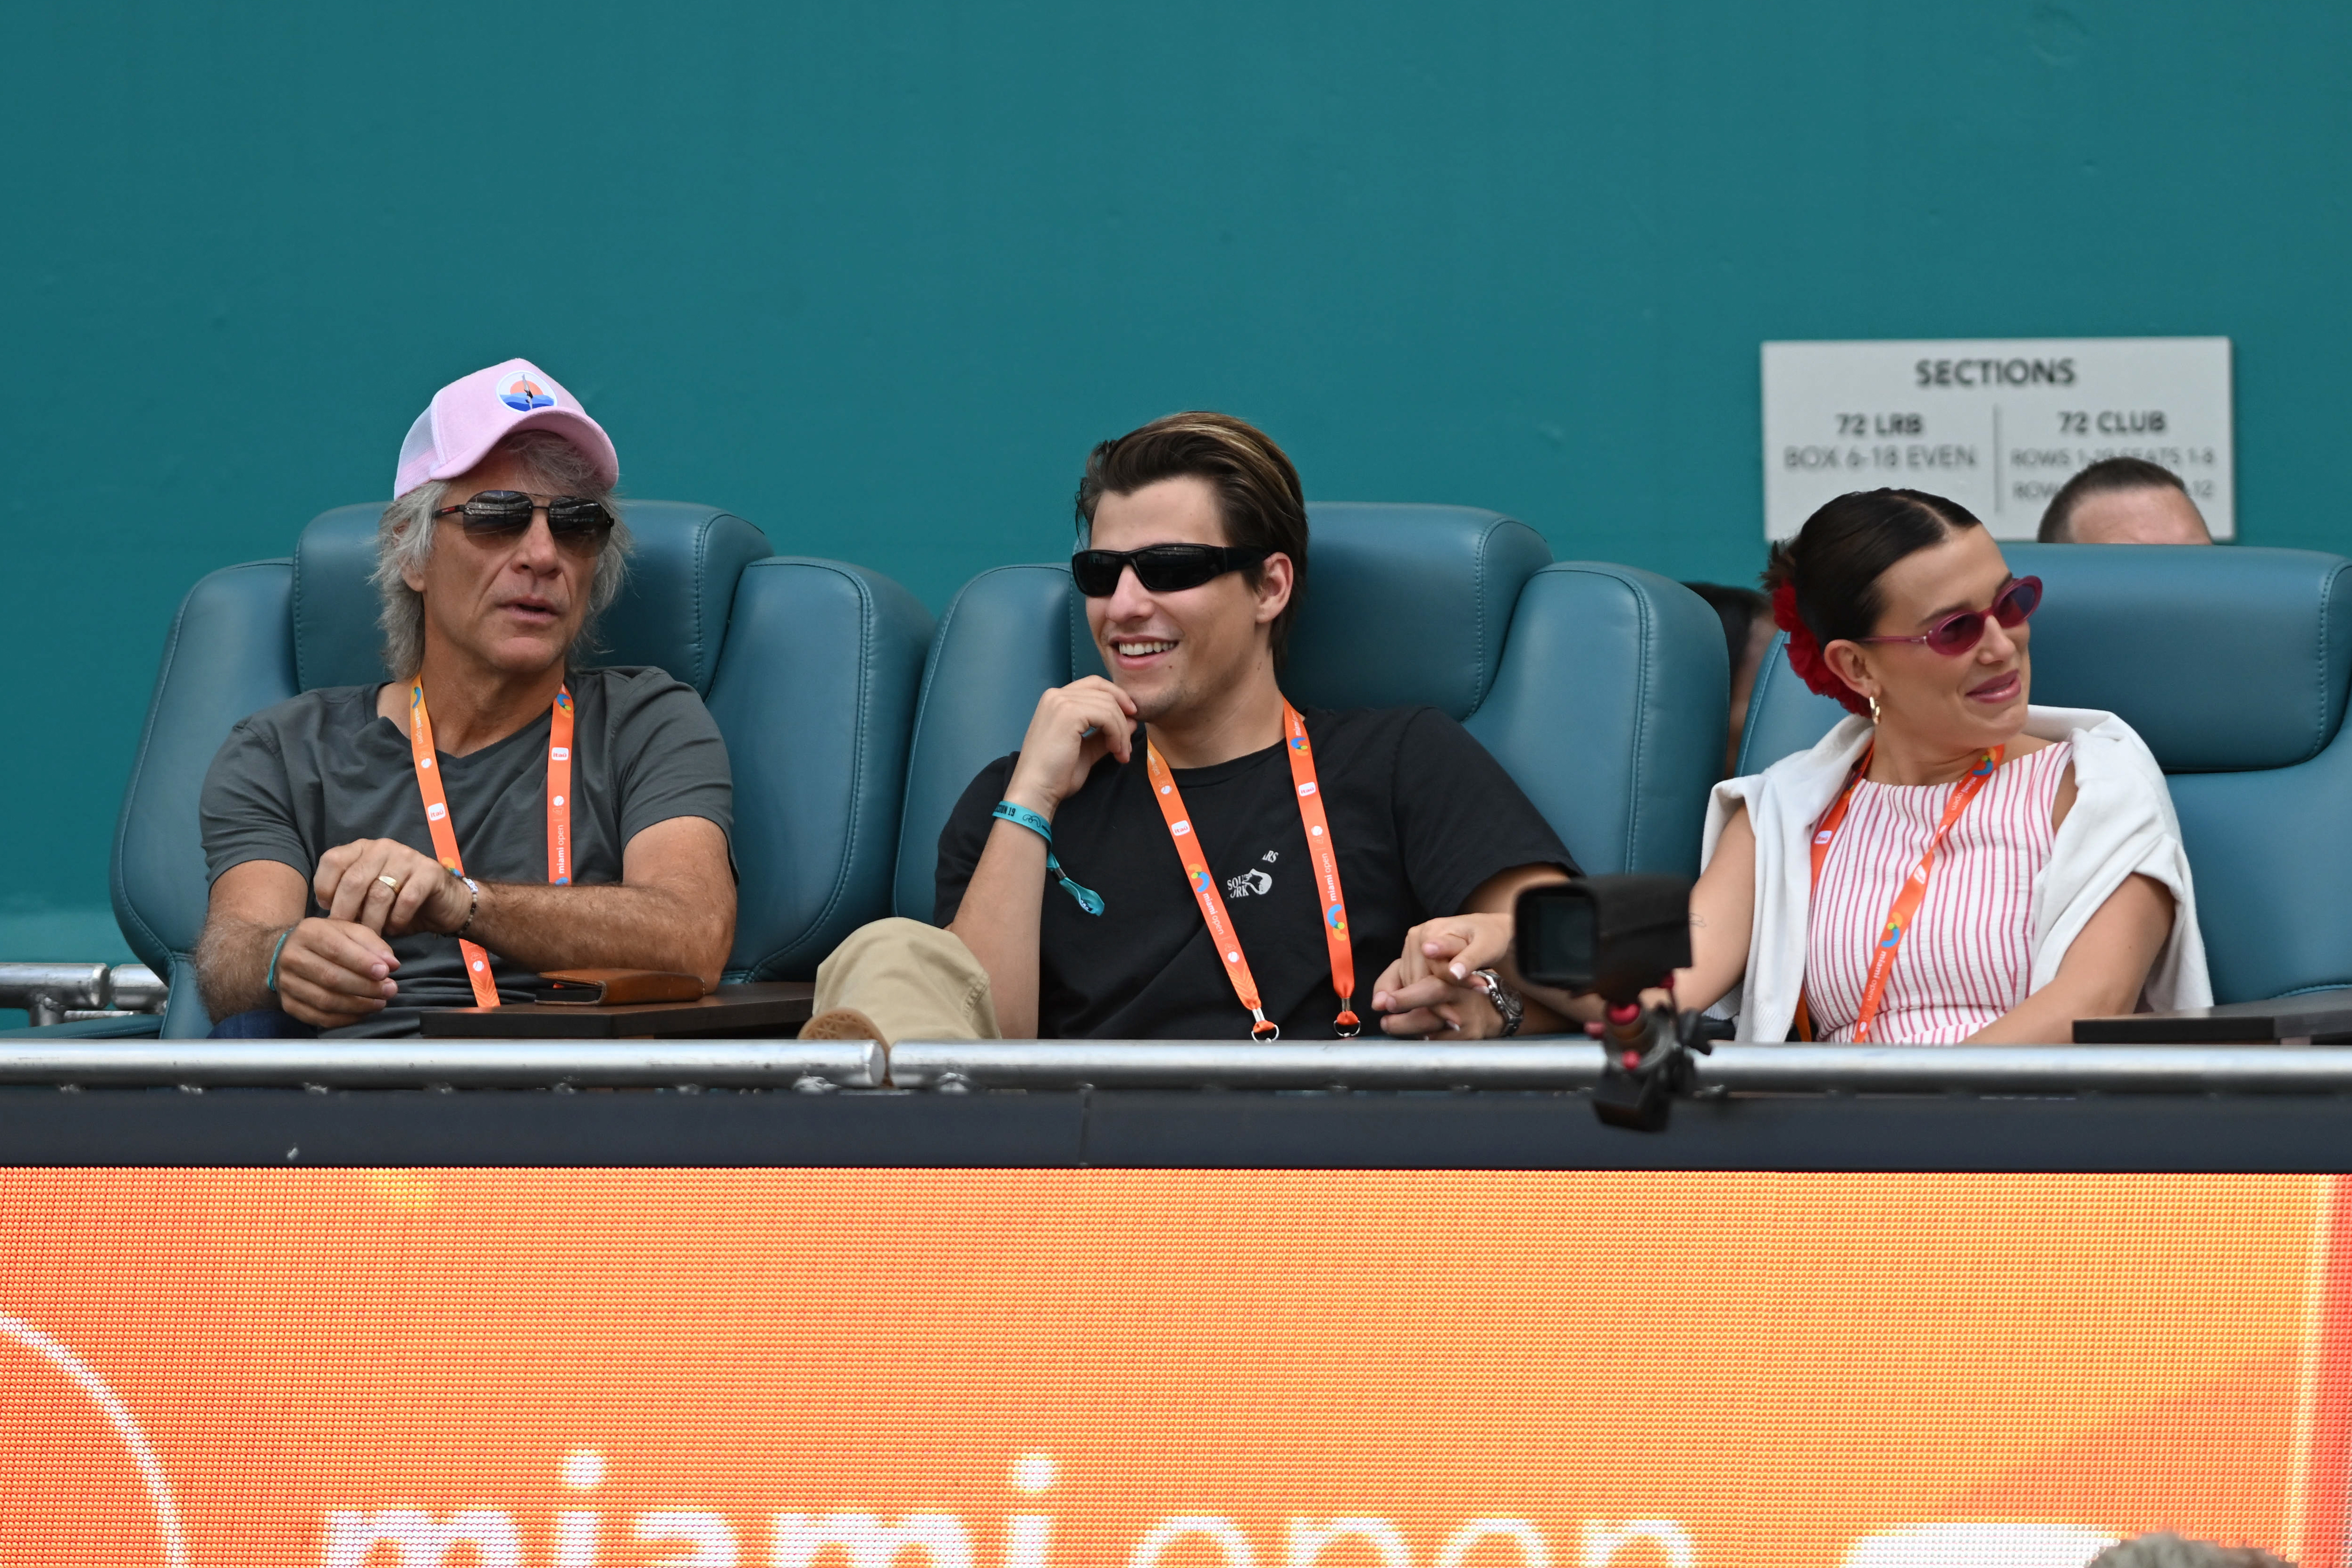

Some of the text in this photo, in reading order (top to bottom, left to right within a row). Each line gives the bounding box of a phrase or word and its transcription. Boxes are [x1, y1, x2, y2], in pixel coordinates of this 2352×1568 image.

[1915, 358, 2076, 386] SECTIONS
[1836, 413, 1924, 436] 72 LRB
[2058, 410, 2167, 433] 72 CLUB
[1784, 445, 1840, 468] BOX
[1906, 444, 1976, 468] EVEN
[2010, 448, 2071, 466] ROWS
[2012, 479, 2058, 499] ROW
[1008, 807, 1016, 817] 19
[558, 824, 566, 846] open
[556, 847, 565, 874] miami
[1322, 853, 1332, 873] open
[1324, 874, 1337, 901] miami
[1203, 893, 1218, 915] miami
[1212, 915, 1224, 935] open
[1867, 951, 1886, 1001] miami open
